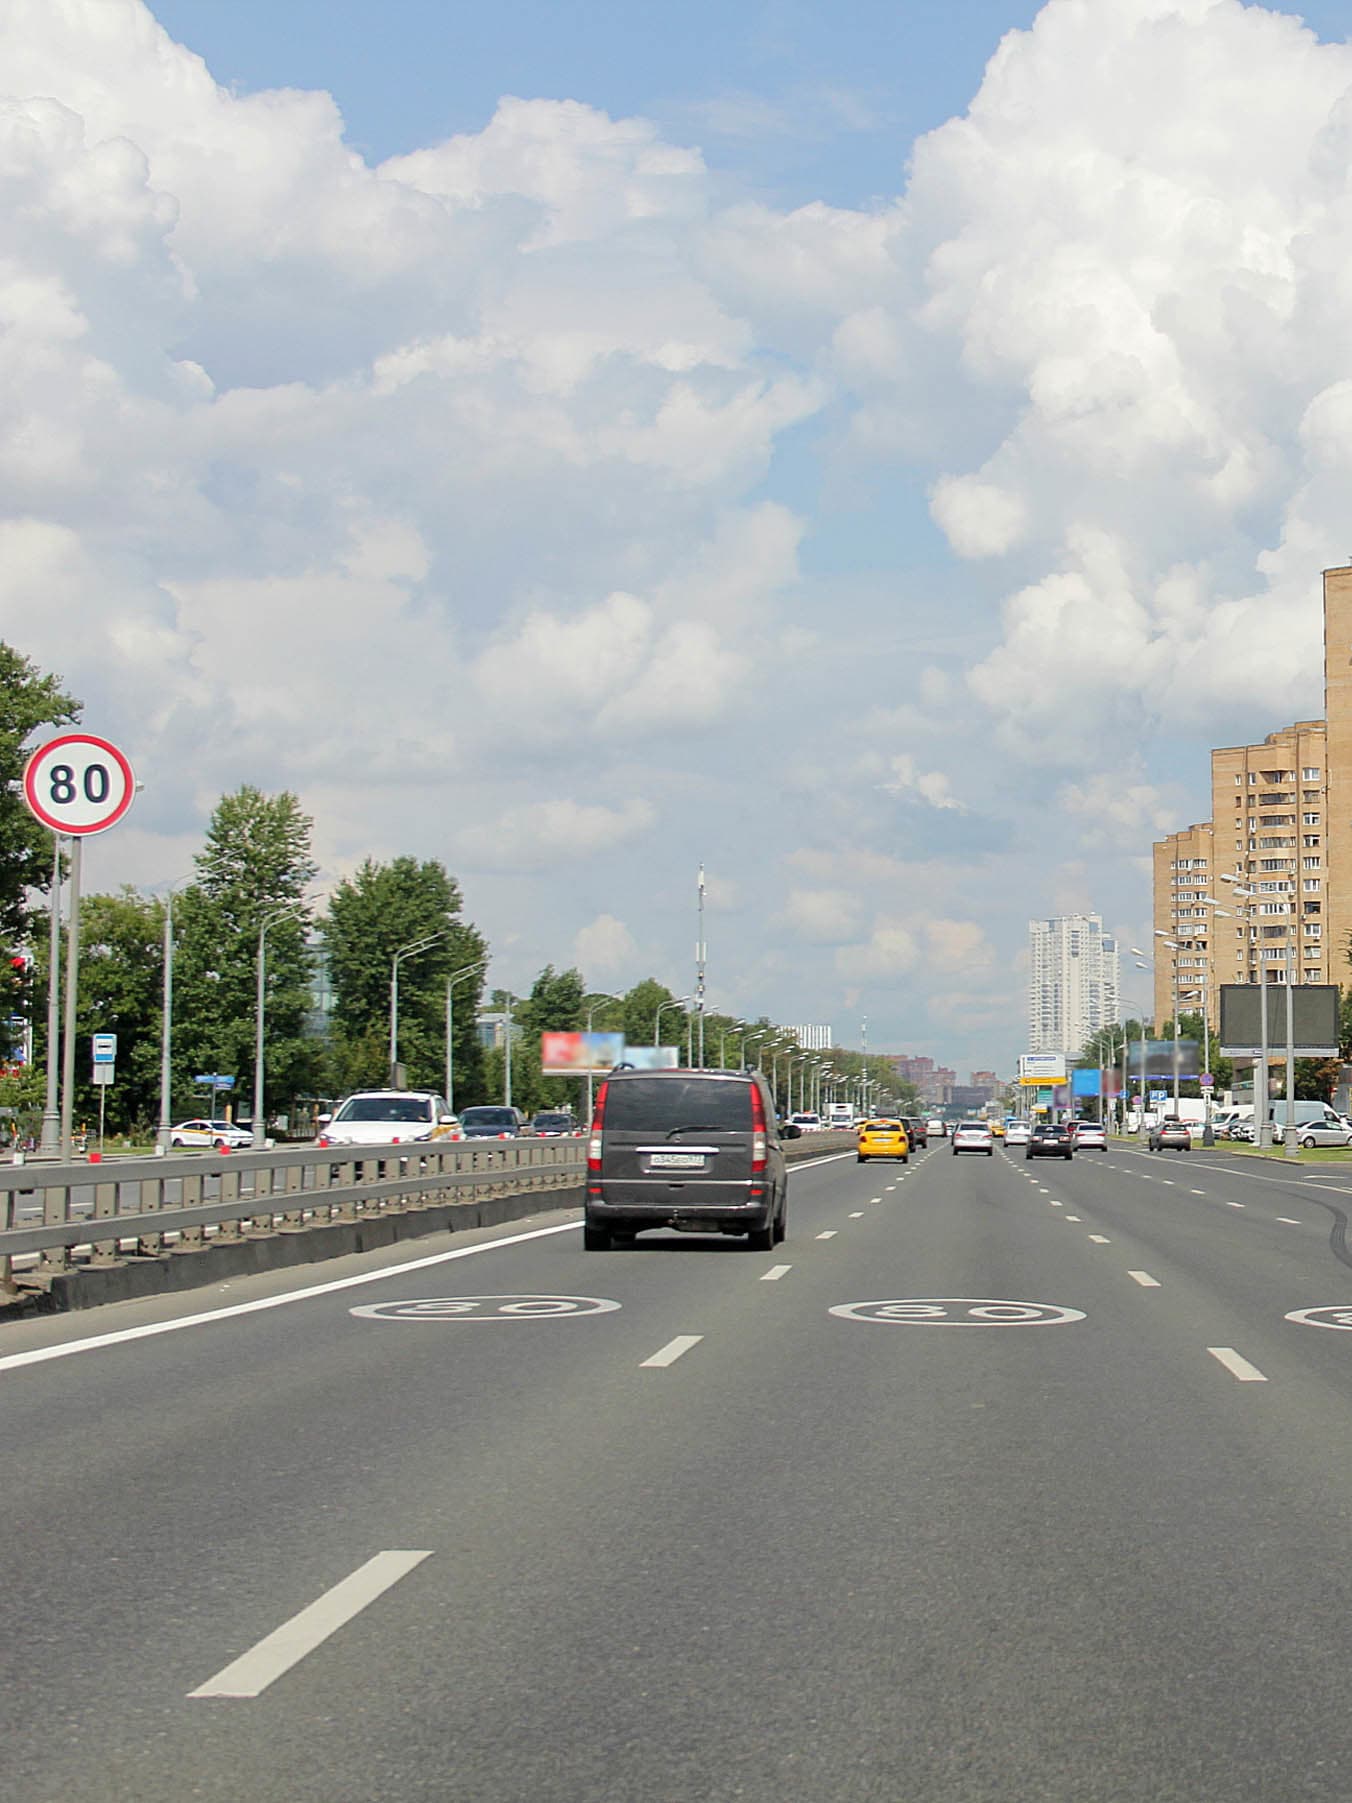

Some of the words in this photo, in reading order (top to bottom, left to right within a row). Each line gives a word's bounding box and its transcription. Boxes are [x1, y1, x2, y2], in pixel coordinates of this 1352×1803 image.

[50, 764, 110, 804] 80
[397, 1301, 578, 1314] 80
[875, 1304, 1043, 1319] 80
